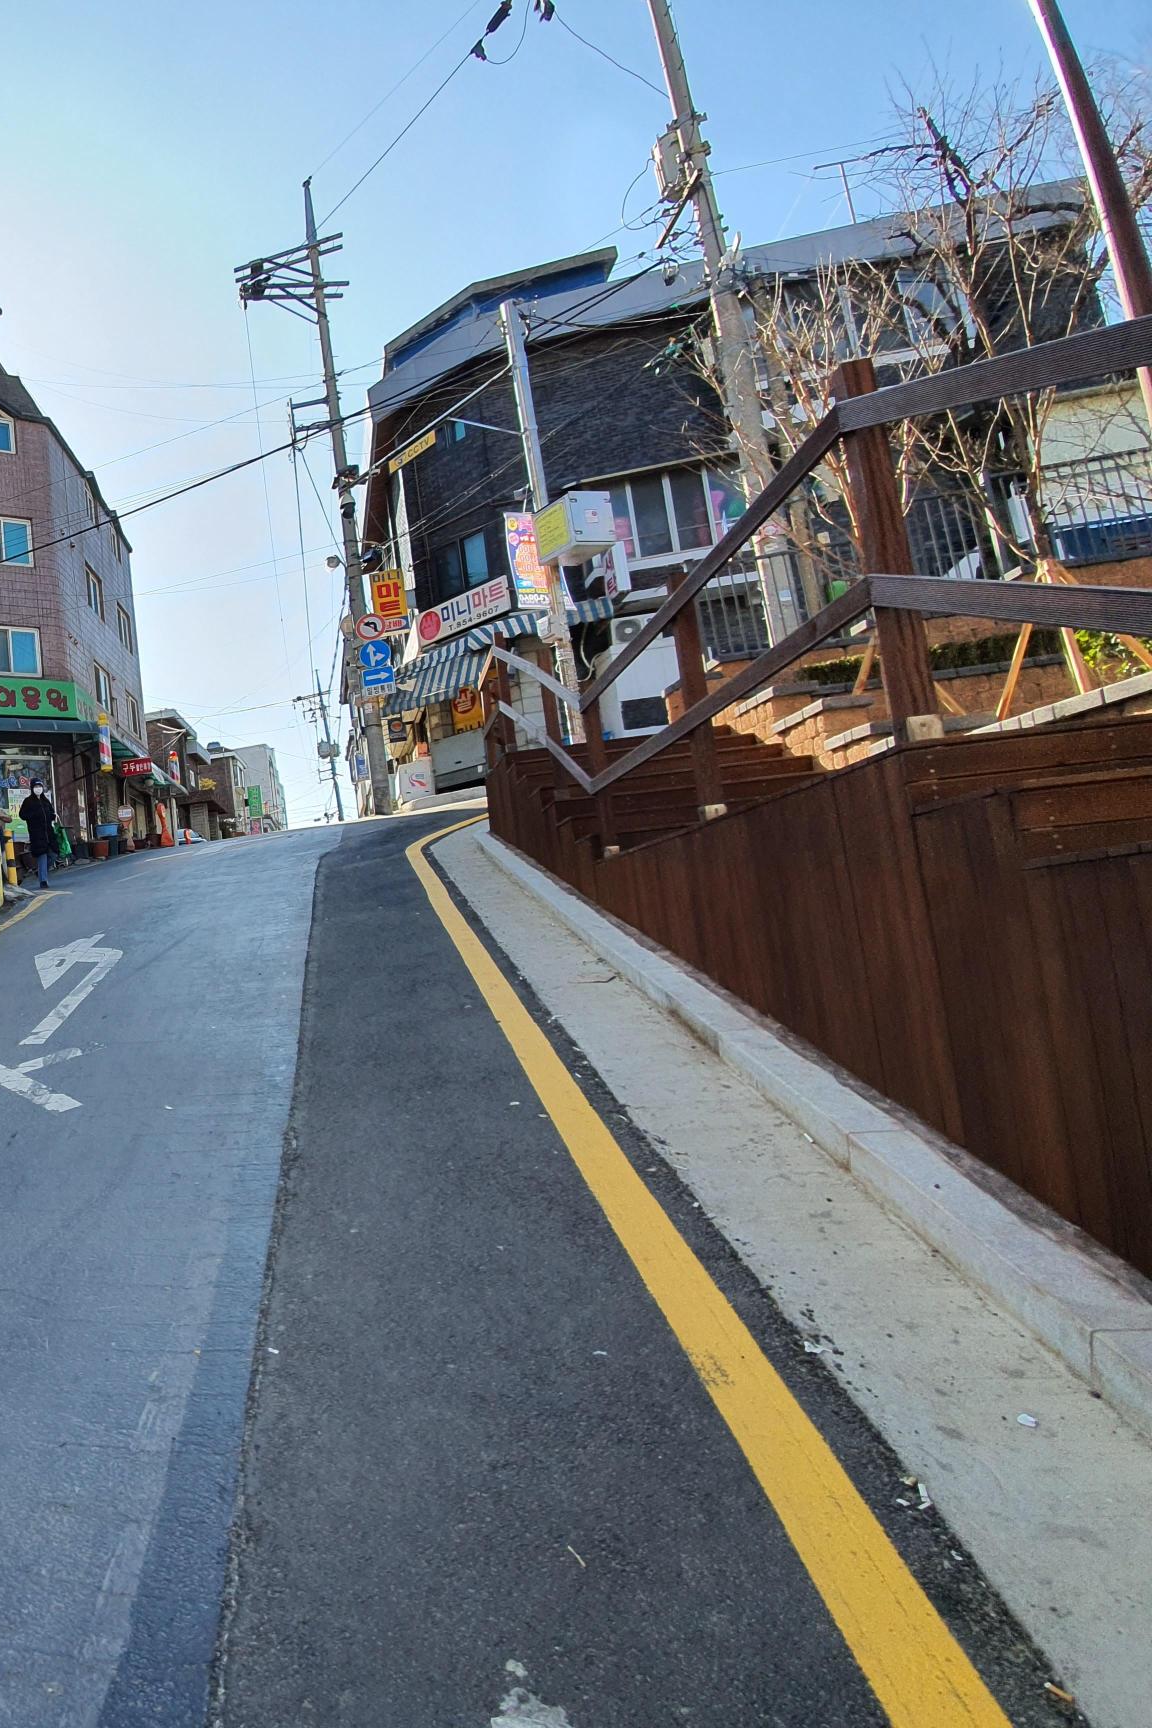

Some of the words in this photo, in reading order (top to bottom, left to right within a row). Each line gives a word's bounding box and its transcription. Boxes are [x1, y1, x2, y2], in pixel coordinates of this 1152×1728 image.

[372, 572, 401, 583] 미니
[376, 582, 403, 618] 마트
[441, 581, 506, 622] 미니마트
[448, 605, 499, 631] T.854-9607
